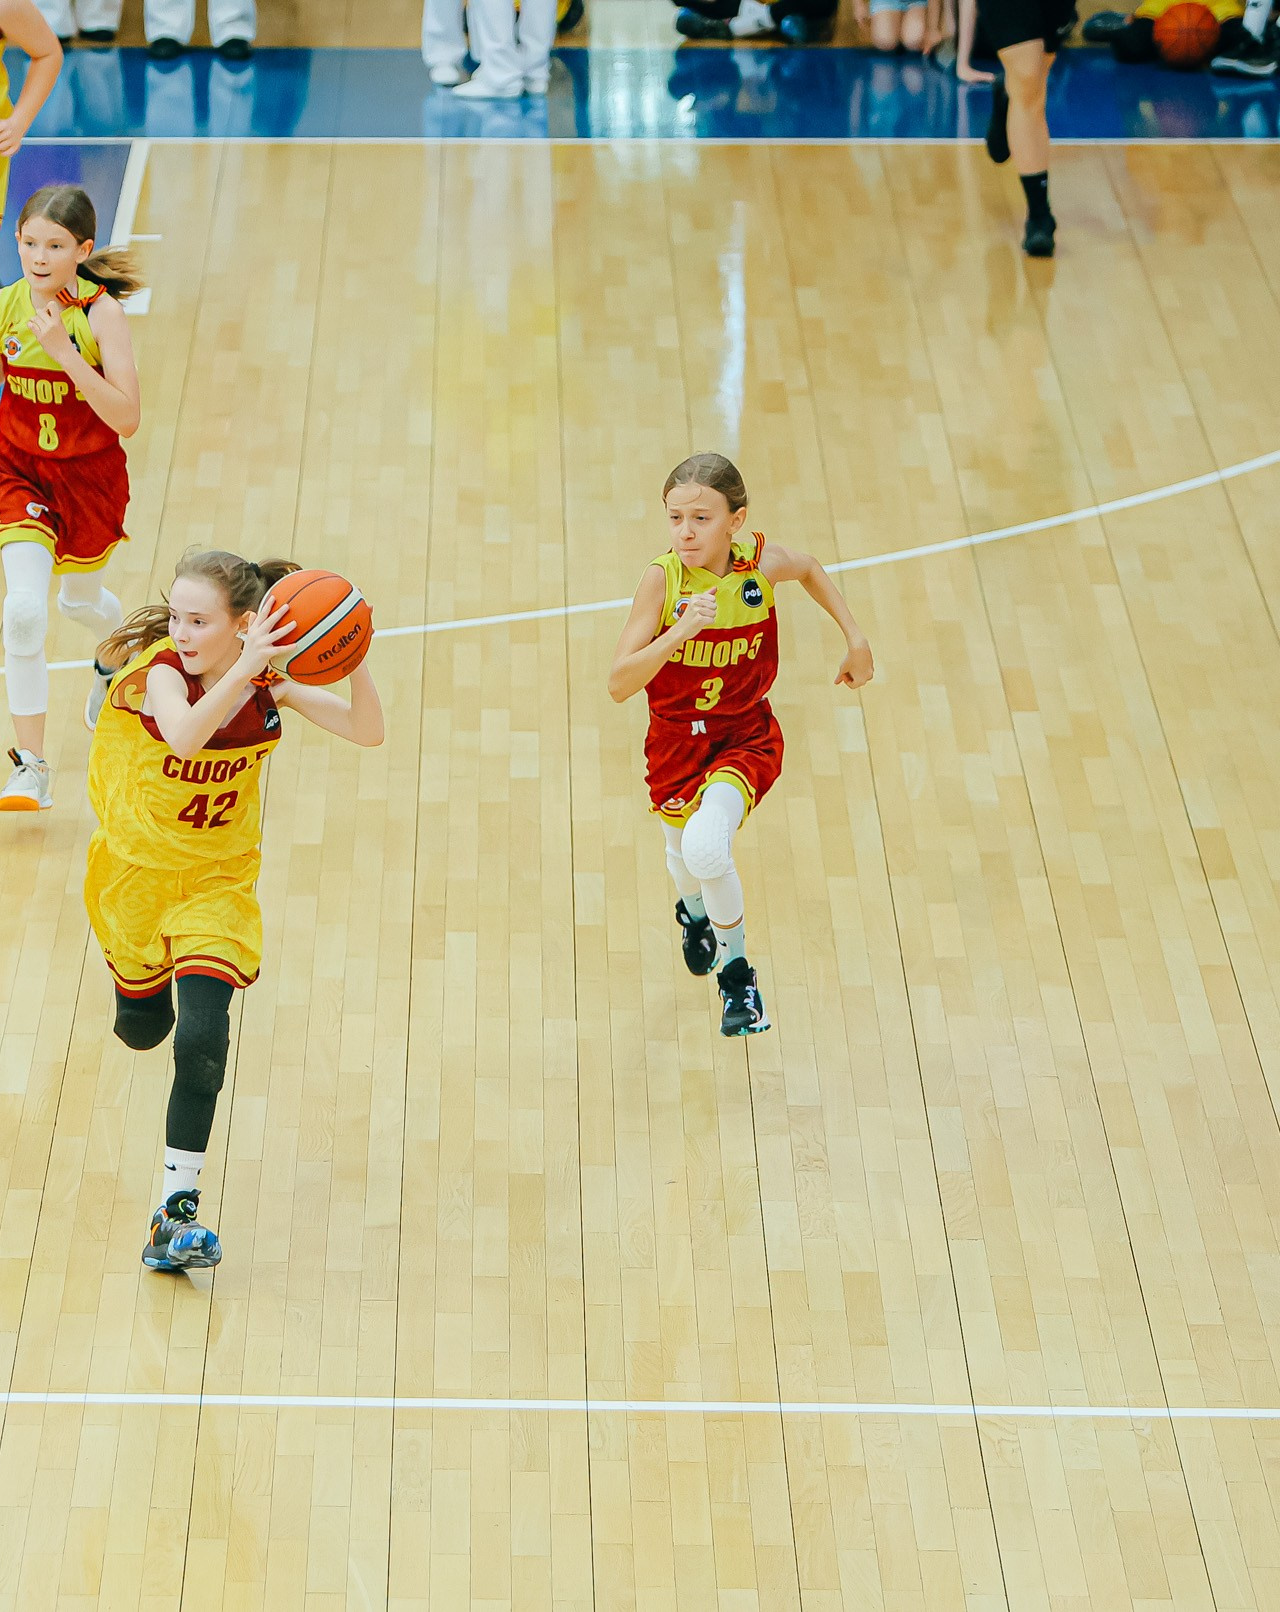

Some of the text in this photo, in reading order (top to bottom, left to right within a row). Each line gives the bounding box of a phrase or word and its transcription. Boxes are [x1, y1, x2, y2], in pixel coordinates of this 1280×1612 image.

[37, 412, 60, 452] 8
[317, 622, 362, 663] molten
[746, 631, 764, 660] 5
[694, 676, 724, 712] 3
[161, 754, 248, 785] СШОР
[176, 790, 240, 829] 42
